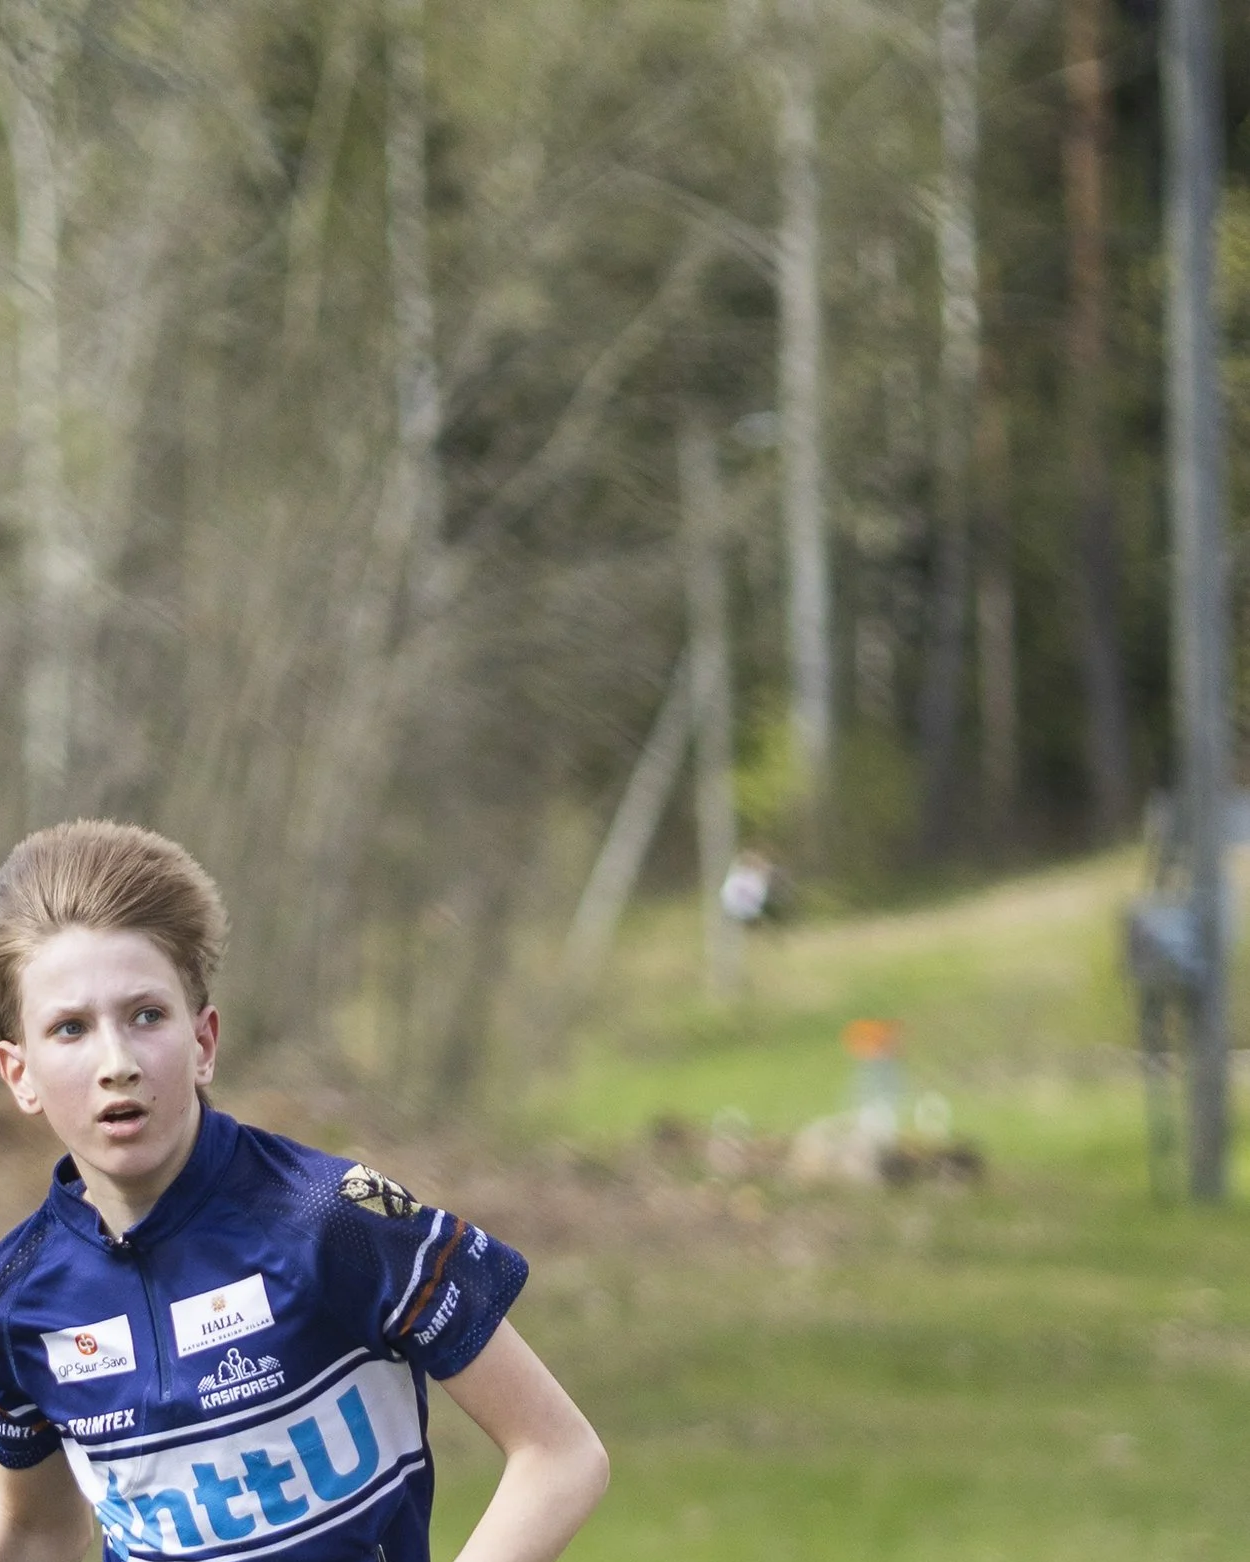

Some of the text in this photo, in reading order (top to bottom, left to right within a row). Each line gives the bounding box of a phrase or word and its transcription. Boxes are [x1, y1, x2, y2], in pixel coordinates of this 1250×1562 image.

[201, 1311, 245, 1336] HALLA
[414, 1281, 461, 1345] TRIMTEX
[58, 1356, 128, 1378] OP Suur-Savo
[200, 1370, 286, 1411] KASIFOREST
[67, 1408, 136, 1437] TRIMTEX
